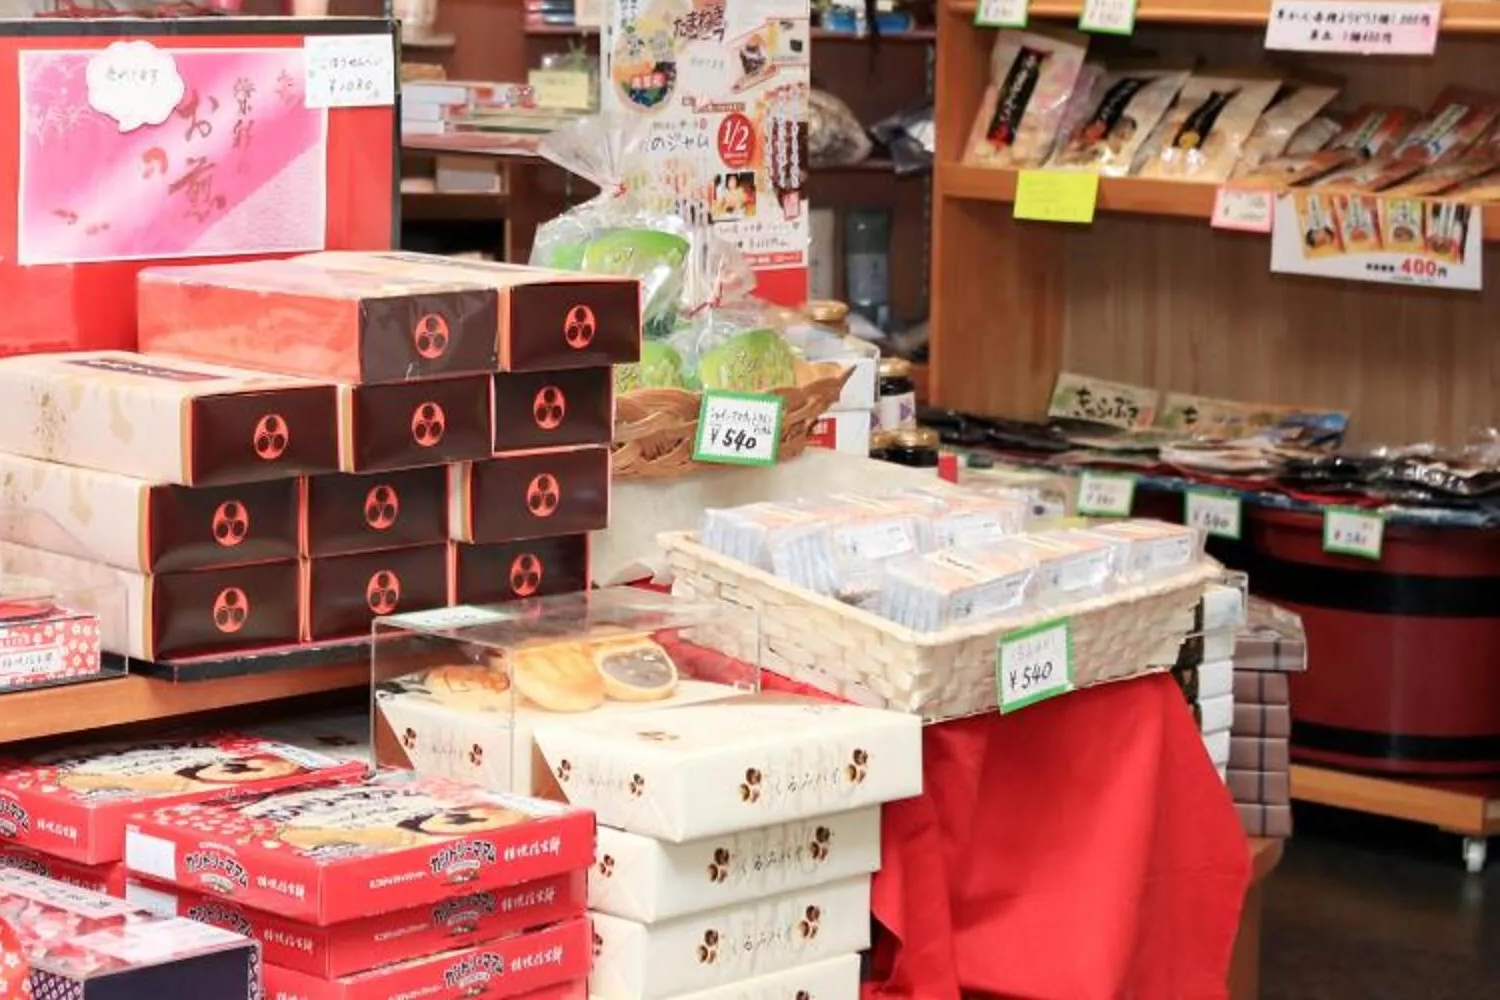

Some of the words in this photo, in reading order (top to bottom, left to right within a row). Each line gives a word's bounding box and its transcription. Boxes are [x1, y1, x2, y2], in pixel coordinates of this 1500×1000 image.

[723, 117, 750, 152] 1/2
[710, 427, 757, 452] ¥540
[1009, 660, 1053, 691] ¥540
